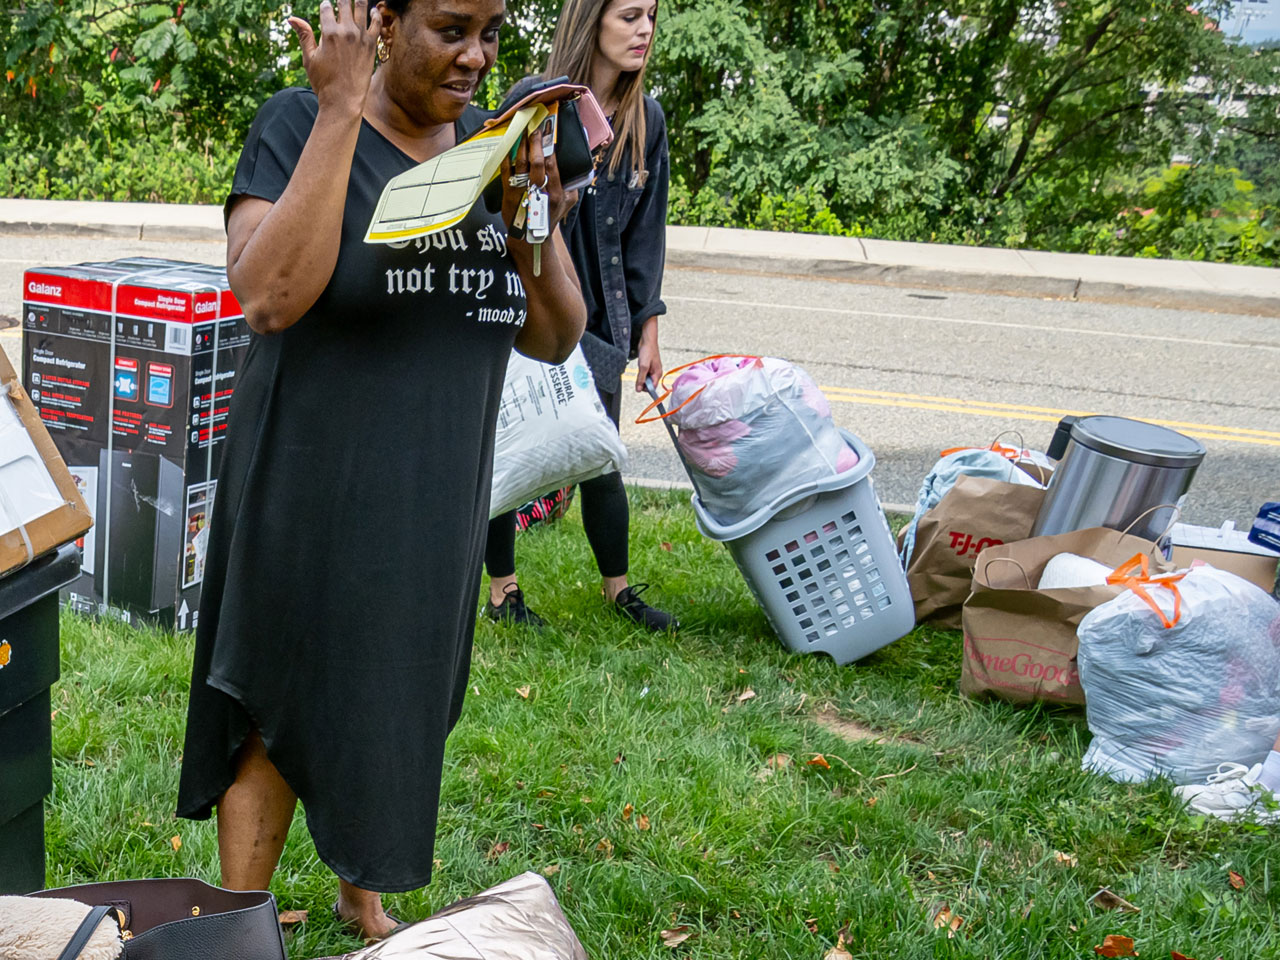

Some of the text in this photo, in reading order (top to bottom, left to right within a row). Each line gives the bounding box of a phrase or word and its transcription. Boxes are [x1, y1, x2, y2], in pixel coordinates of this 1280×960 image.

[476, 223, 508, 257] sh
[28, 281, 62, 297] Galanz
[385, 262, 527, 300] not try m
[195, 301, 221, 315] Galan
[477, 306, 515, 324] mood
[33, 354, 86, 370] Compact Refrigerator
[558, 364, 575, 402] NATURAL
